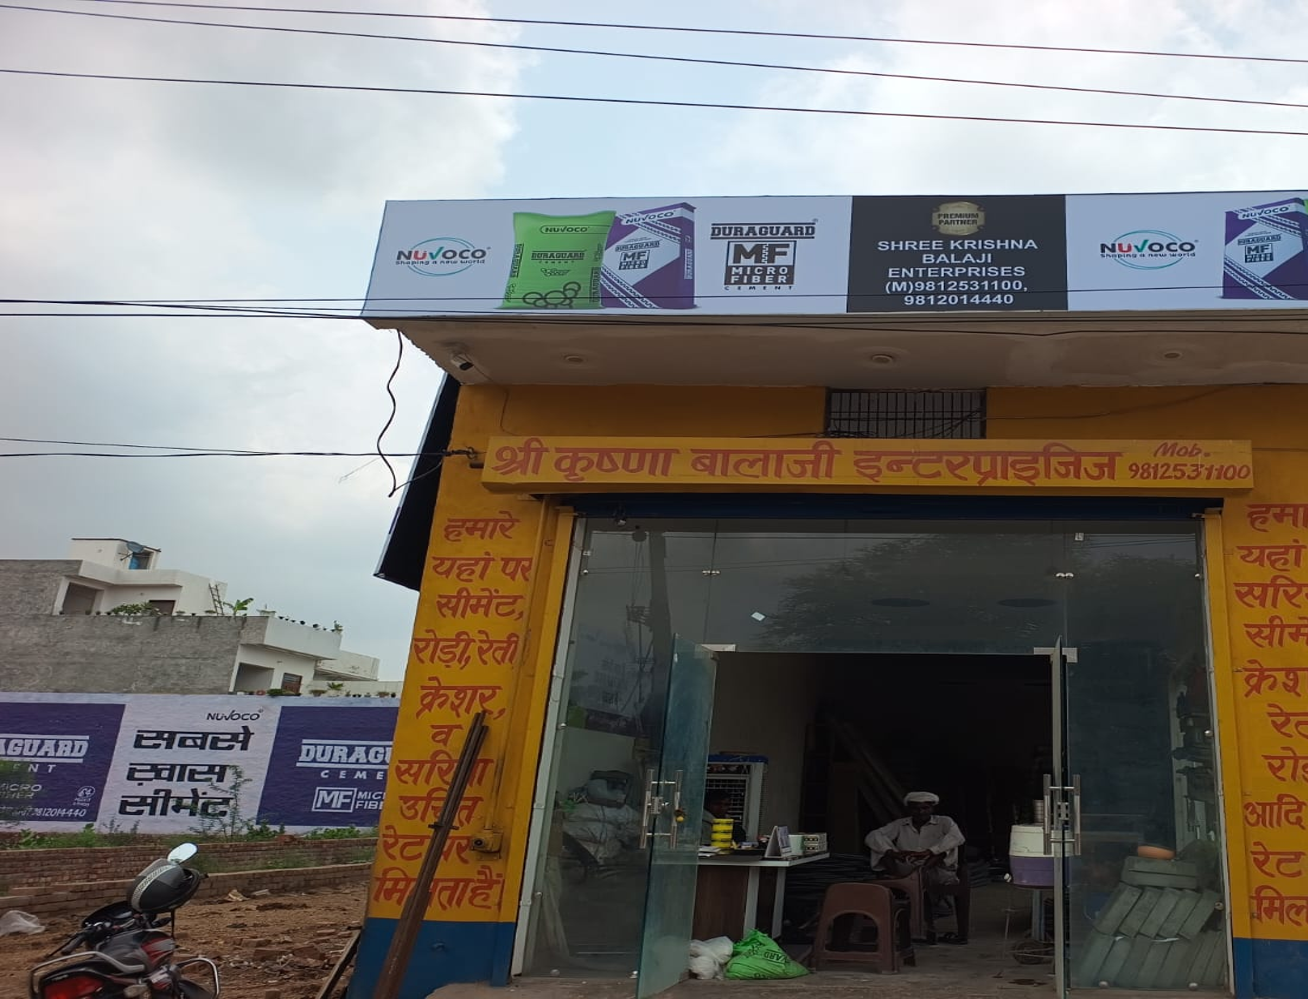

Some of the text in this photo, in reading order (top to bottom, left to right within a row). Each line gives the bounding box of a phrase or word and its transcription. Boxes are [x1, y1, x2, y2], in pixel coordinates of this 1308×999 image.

[625, 210, 674, 225] NUVOCO
[937, 212, 979, 220] PREMIUM
[1242, 205, 1290, 219] NUVOCO
[544, 225, 590, 234] NUVOCO
[937, 218, 979, 226] PARTNER
[709, 222, 817, 240] DURAGUARD
[877, 239, 1038, 251] SHREE KRISHNA
[1099, 237, 1196, 254] NUVOCO
[395, 246, 488, 262] NUVOCO
[731, 243, 792, 266] MF
[922, 252, 993, 264] BALAJI
[731, 265, 789, 275] MICRO
[887, 266, 1026, 278] ENTERPRISES
[729, 274, 790, 284] FIBER
[885, 280, 1028, 294] (M)9812531100,
[903, 293, 1014, 306] 9812014440
[1151, 438, 1211, 458] Mob.
[491, 437, 843, 480] श्री बालाजी
[1126, 459, 1251, 483] 9812531100
[444, 511, 523, 543] हमारे
[1236, 537, 1307, 571] यहां
[432, 550, 534, 583] यहां पर
[436, 588, 525, 622] सीमेंट,
[416, 675, 509, 722] क्रेशर,
[206, 709, 261, 722] NUVOCO
[132, 725, 254, 751] सबसे
[430, 723, 465, 750] व
[118, 787, 235, 818] सीमेंट
[322, 792, 352, 807] MF
[1244, 792, 1307, 830] आदि
[1250, 840, 1306, 879] रेट
